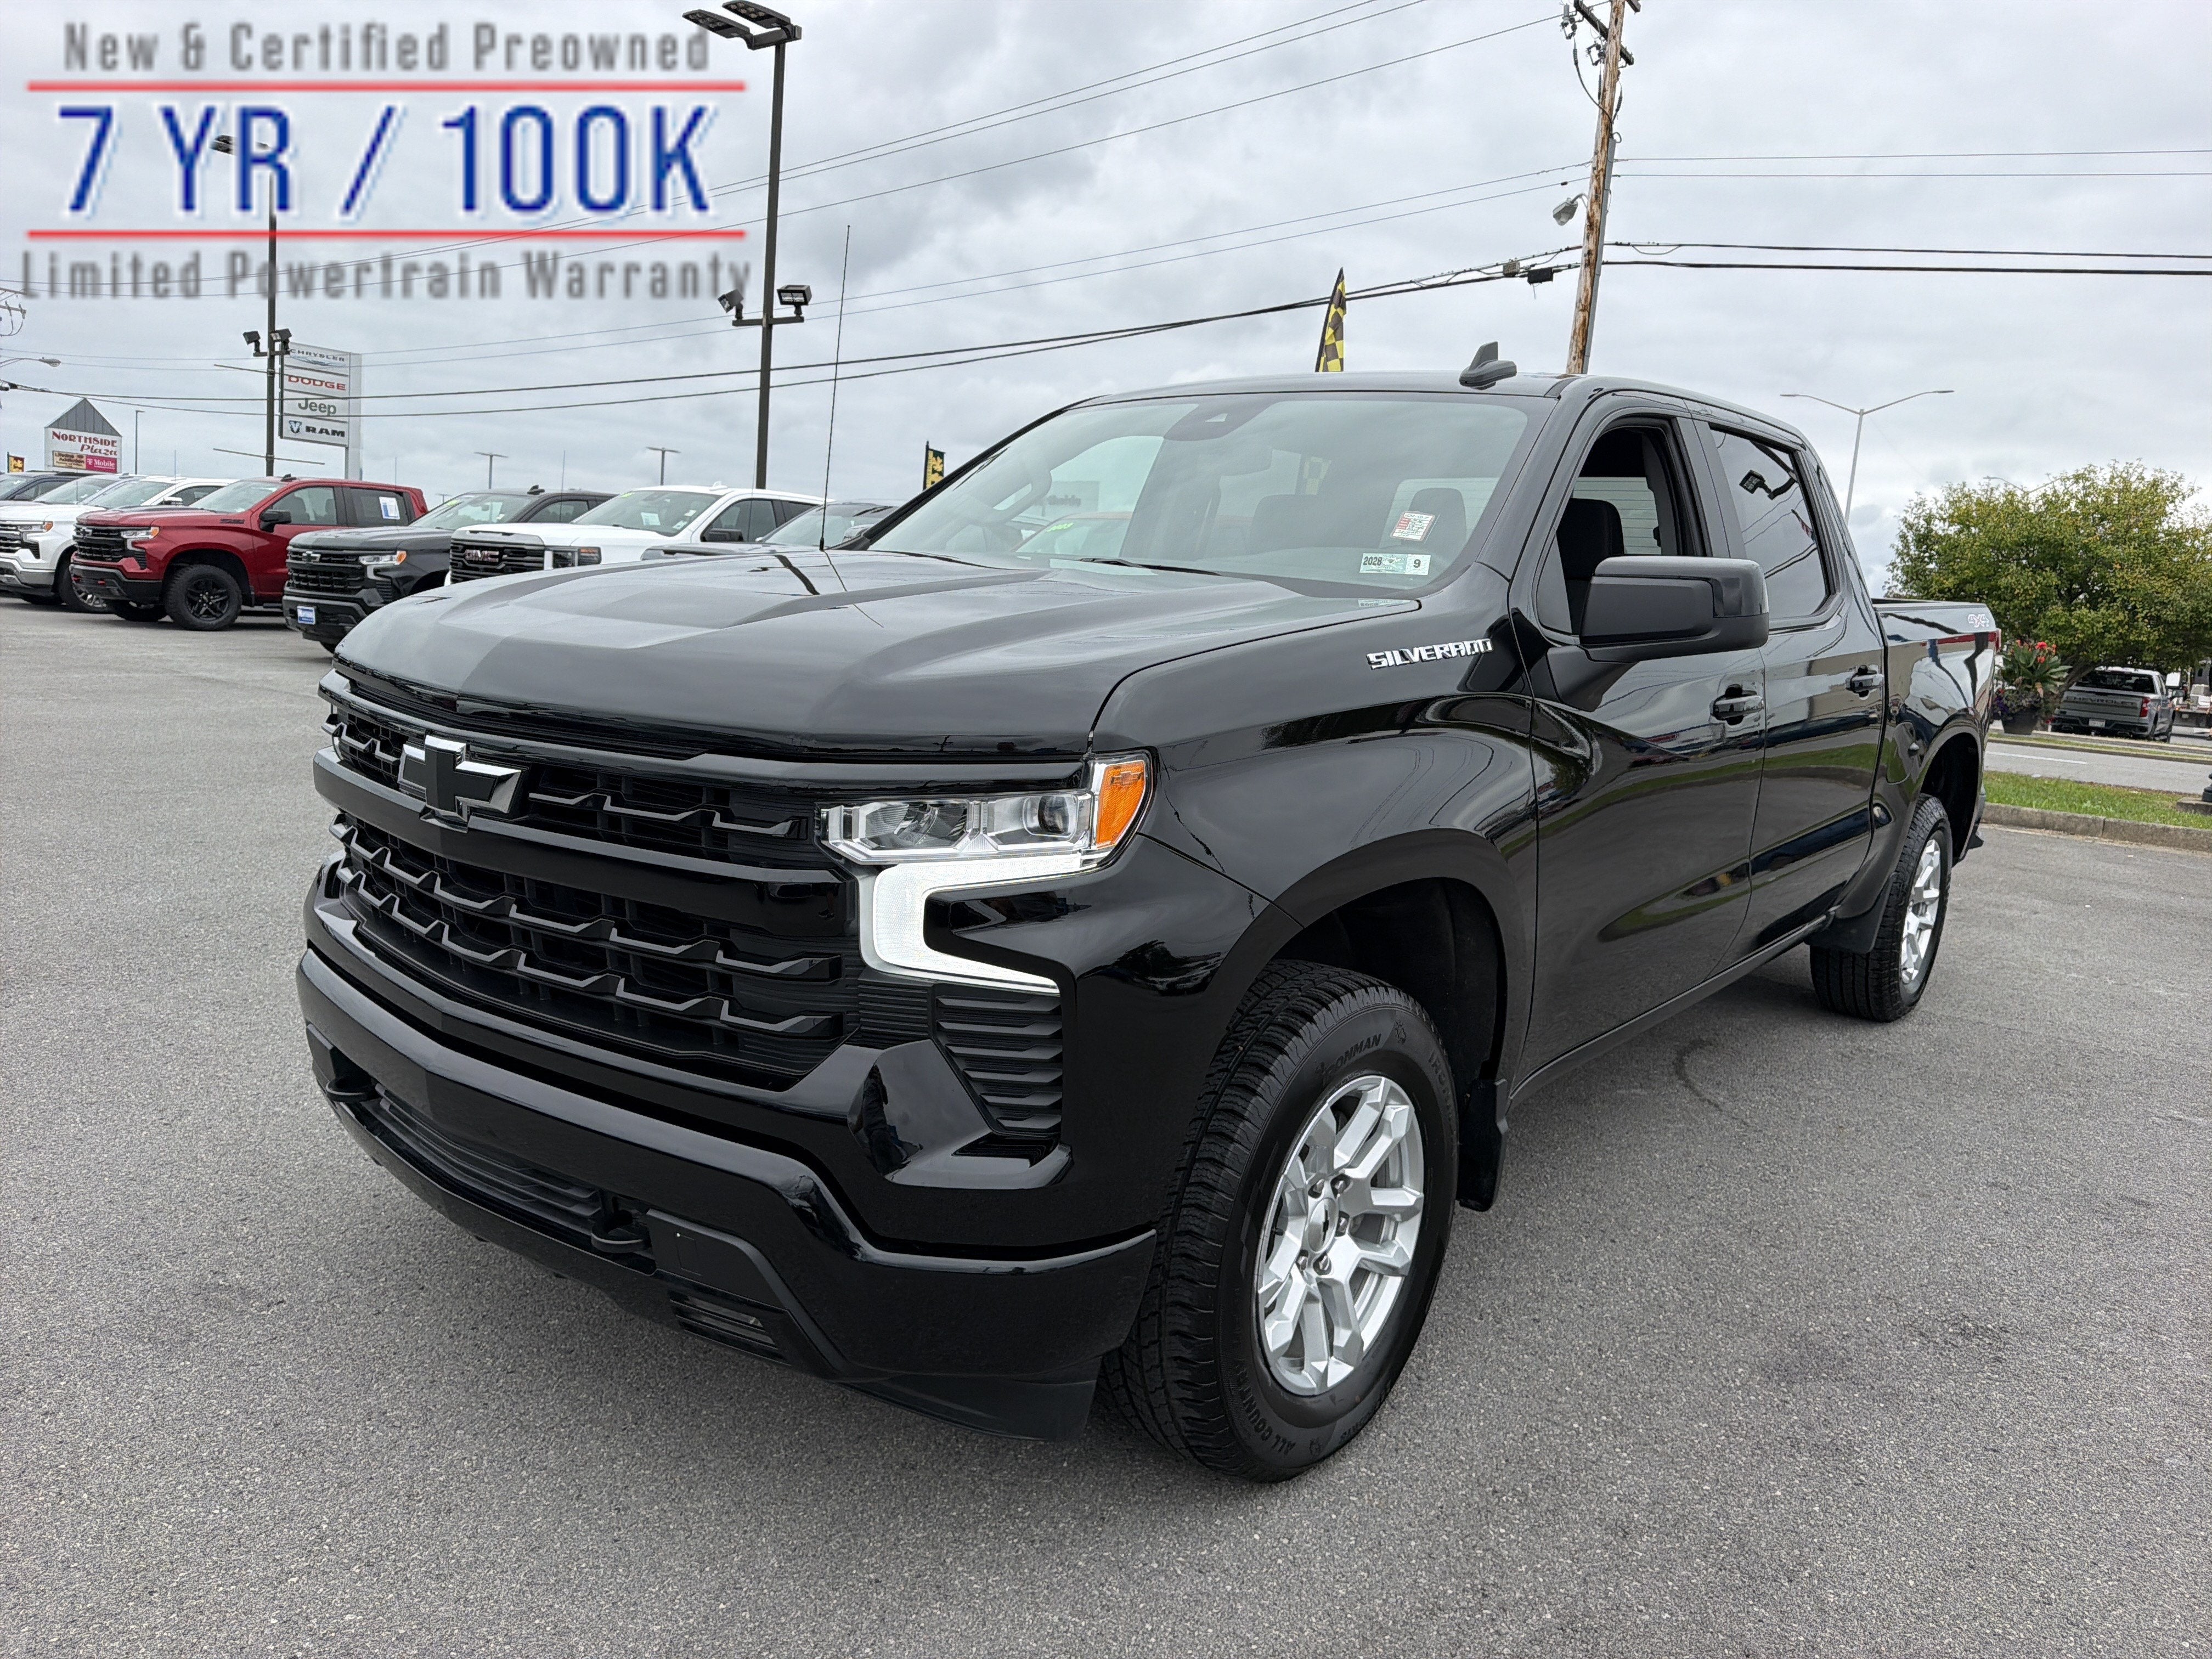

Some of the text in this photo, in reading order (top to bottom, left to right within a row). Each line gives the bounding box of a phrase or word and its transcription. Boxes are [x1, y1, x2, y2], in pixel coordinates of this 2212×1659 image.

[290, 348, 345, 362] CHRYSLER
[288, 374, 346, 391] DODGE
[298, 398, 336, 416] Jeep
[305, 425, 345, 437] RAM
[80, 444, 117, 456] Plaza
[465, 549, 499, 563] GMC
[1363, 556, 1421, 568] 2028 9
[1366, 637, 1493, 669] SILVERADO
